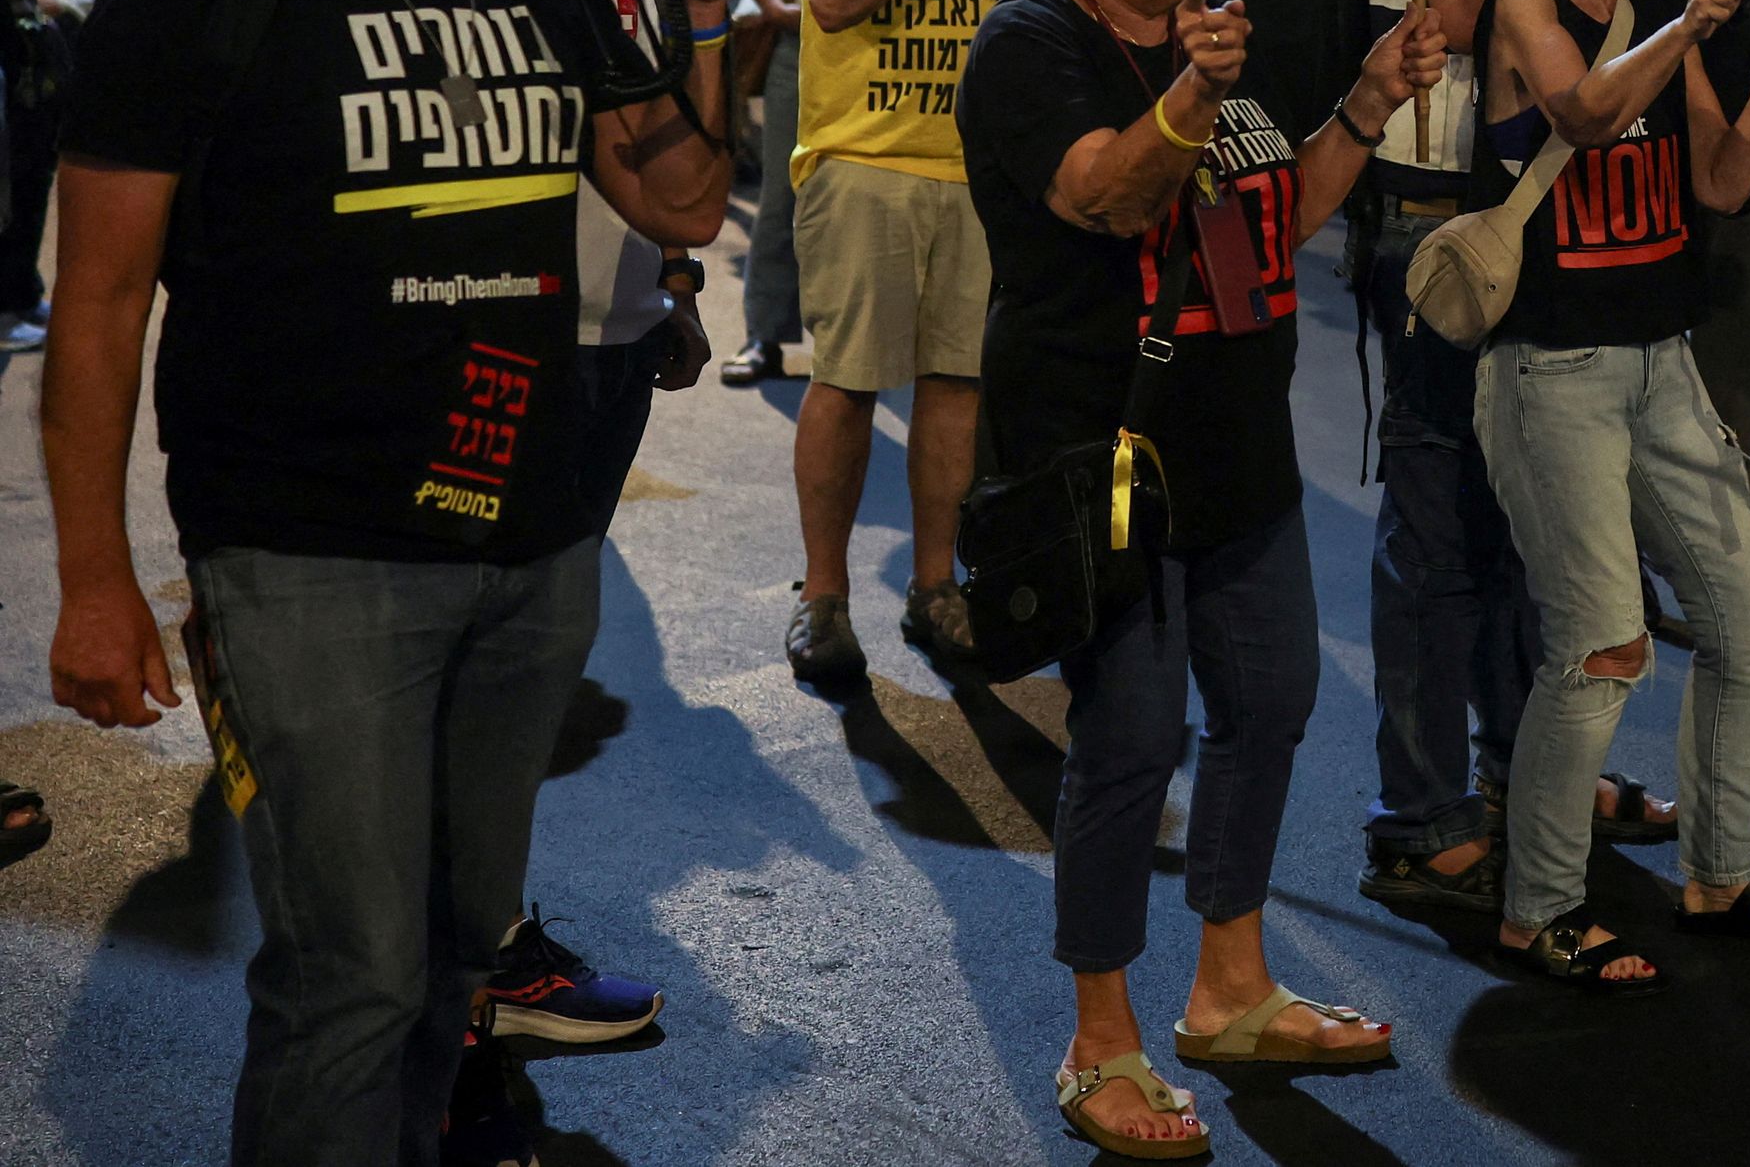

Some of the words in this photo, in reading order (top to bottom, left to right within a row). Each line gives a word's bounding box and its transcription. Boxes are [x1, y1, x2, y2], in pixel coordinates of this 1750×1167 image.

[346, 5, 564, 81] בוחרים
[462, 359, 533, 418] ביבי
[448, 410, 517, 466] בוגד
